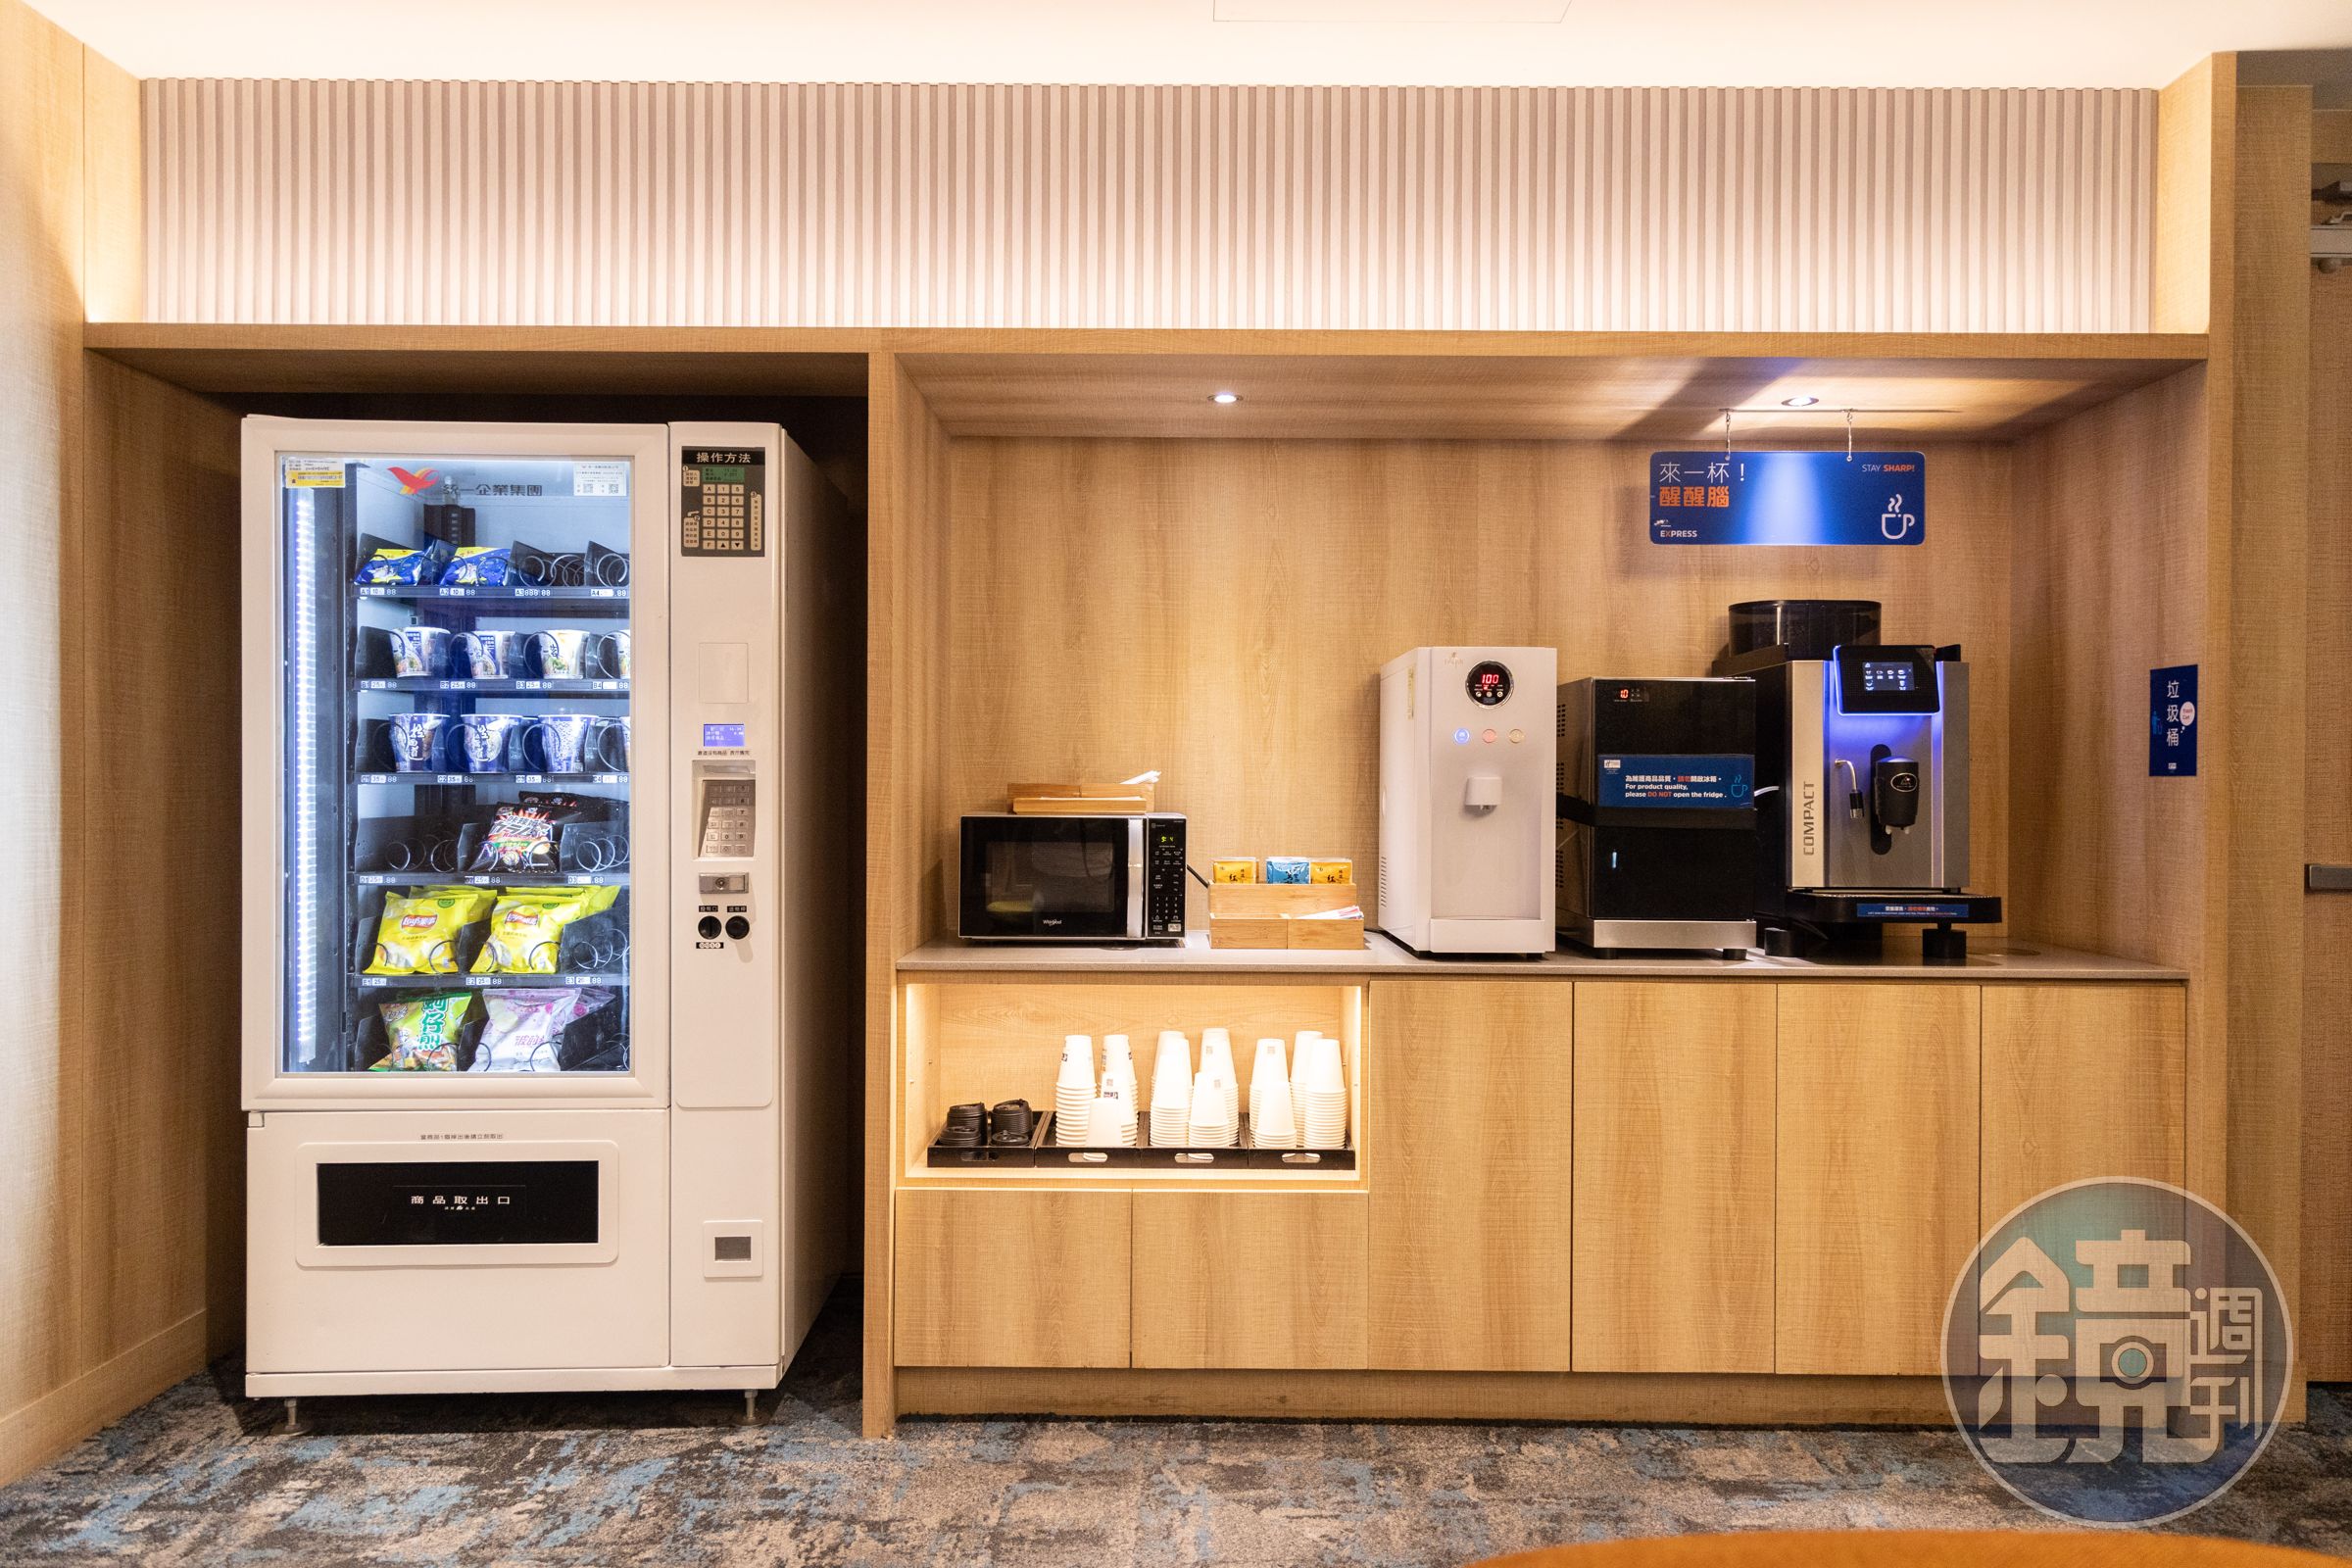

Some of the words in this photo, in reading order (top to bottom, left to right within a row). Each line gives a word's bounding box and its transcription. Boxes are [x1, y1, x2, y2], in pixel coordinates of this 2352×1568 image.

[696, 452, 752, 464] 操作方法
[1861, 464, 1882, 472] STAY
[1883, 464, 1915, 472] SHARP!
[1659, 485, 1730, 508] 醒醒腦
[1482, 674, 1499, 684] 100
[2167, 680, 2180, 747] 垃圾桶
[1638, 783, 1663, 792] product
[1664, 783, 1689, 792] quality,
[1803, 780, 1815, 856] COMPACT
[411, 1195, 510, 1205] 商品取出口
